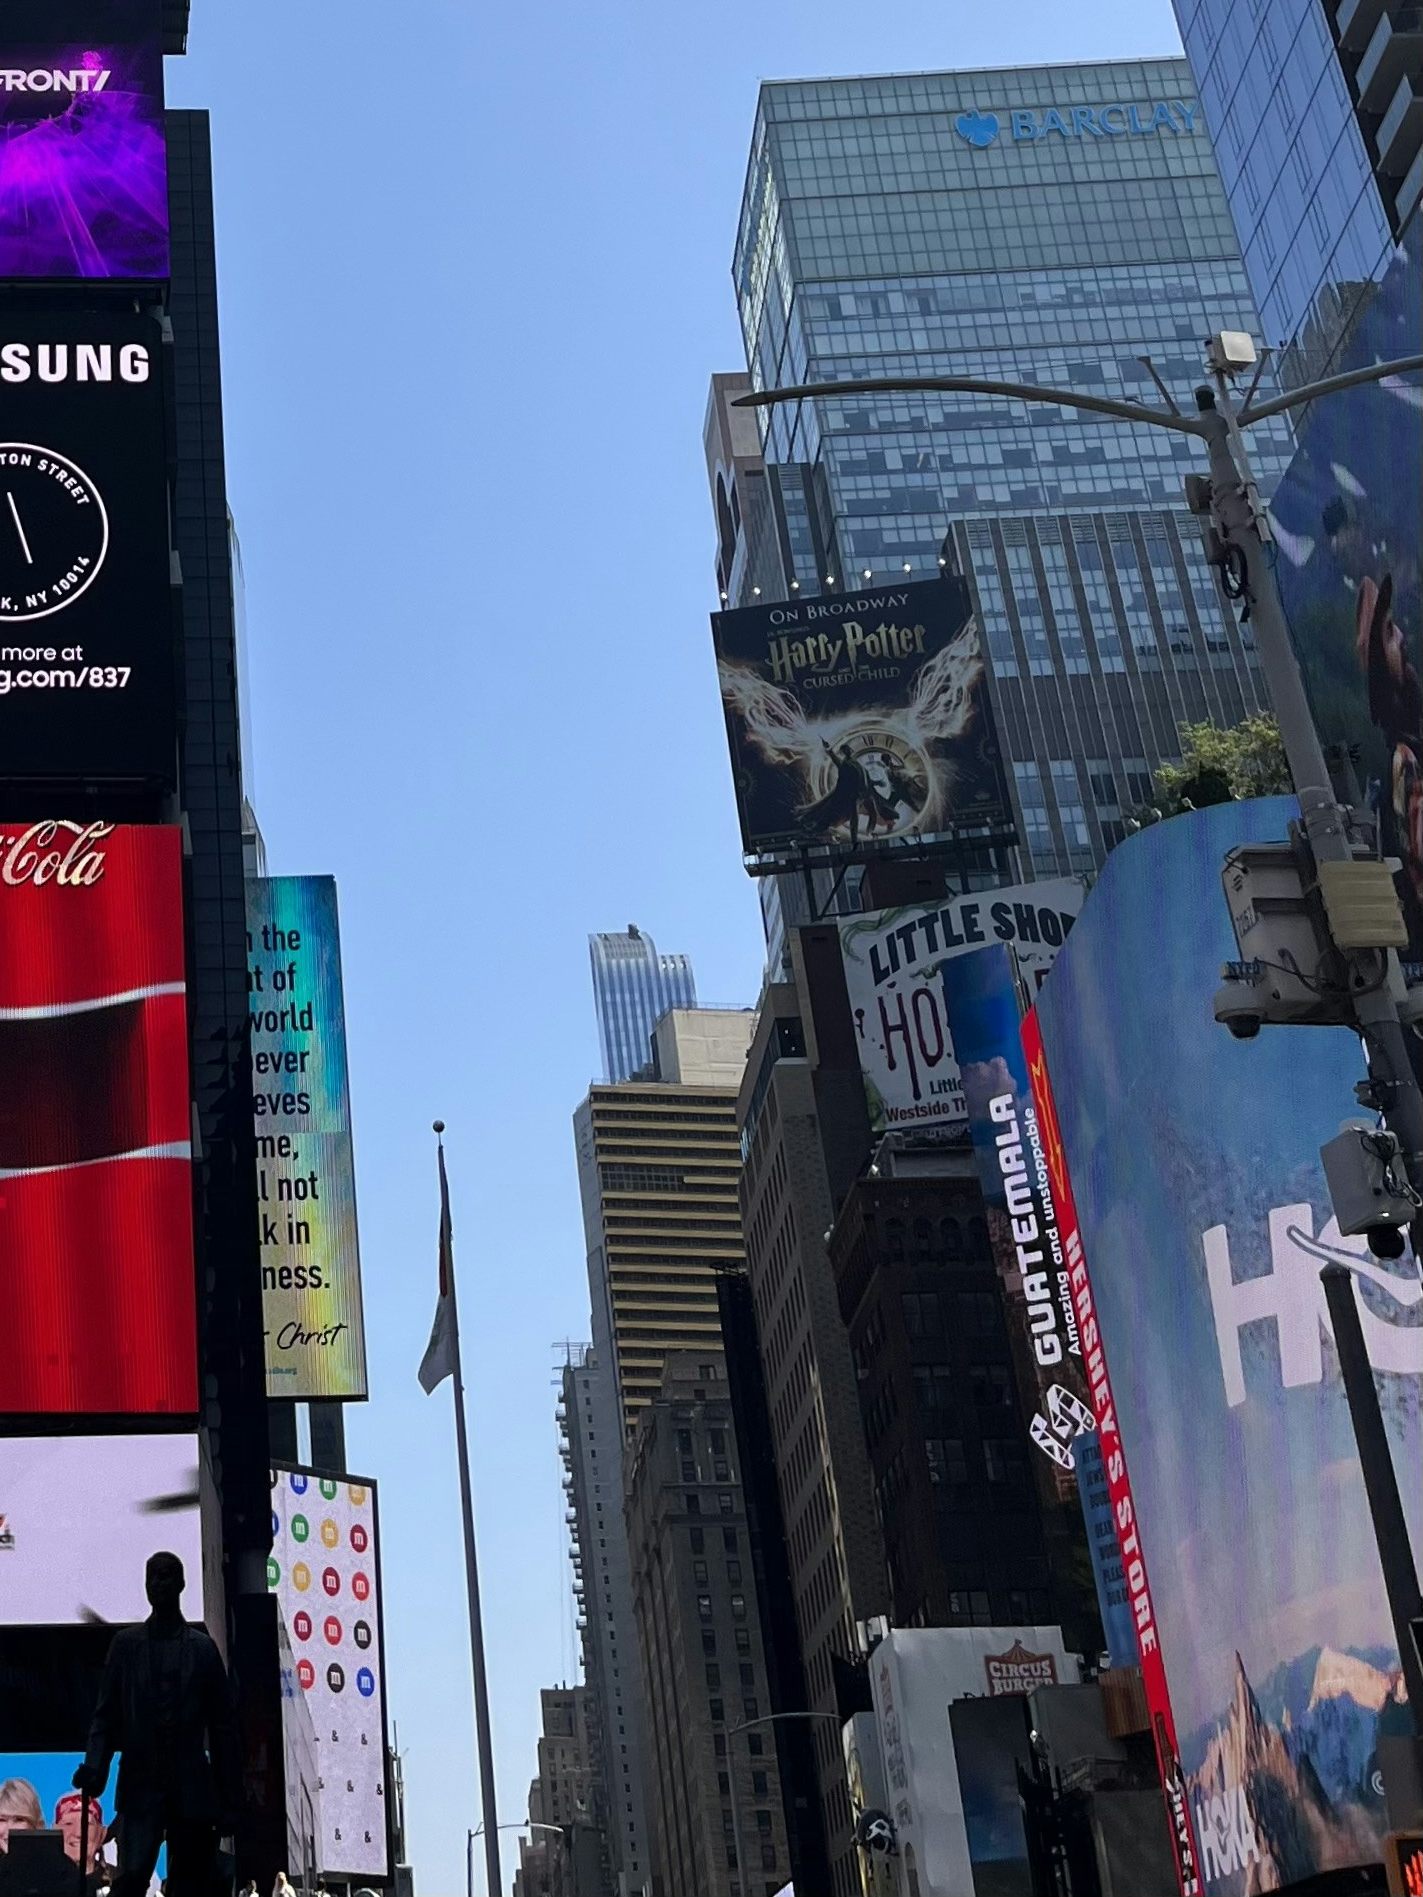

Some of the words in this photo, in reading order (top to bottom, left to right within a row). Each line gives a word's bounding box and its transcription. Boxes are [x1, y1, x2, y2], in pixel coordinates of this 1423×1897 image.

[1010, 100, 1201, 142] BARCLAY
[37, 458, 90, 506] STREET
[26, 590, 48, 609] NY
[52, 555, 91, 597] 10014
[1, 647, 57, 662] more
[61, 645, 84, 662] at
[765, 633, 843, 684] Harry
[842, 621, 926, 677] Potter
[803, 673, 855, 690] CURSED
[858, 666, 901, 681] CHILD
[262, 922, 301, 952] the
[869, 903, 986, 987] LITTLE
[272, 961, 297, 992] of
[253, 1050, 310, 1074] ever
[254, 1091, 311, 1116] eves
[886, 1100, 950, 1122] Westside
[1024, 1107, 1055, 1224] unstoppable
[278, 1170, 320, 1202] not
[287, 1213, 311, 1245] in
[989, 1093, 1063, 1366] GUATEMALA
[1045, 1228, 1064, 1265] and
[262, 1264, 331, 1290] ness.
[1057, 1271, 1082, 1356] Amazing
[276, 1321, 348, 1350] Christ
[1065, 1229, 1125, 1484] HERSHEY'S
[1116, 1494, 1157, 1657] STORE
[295, 1522, 306, 1535] m
[325, 1527, 335, 1540] m
[354, 1532, 364, 1545] m
[297, 1570, 306, 1583] m
[326, 1575, 336, 1588] m
[355, 1580, 366, 1593] m
[298, 1619, 308, 1632] m
[328, 1624, 338, 1637] m
[358, 1629, 368, 1641] m
[300, 1668, 311, 1681] m
[331, 1672, 342, 1685] m
[361, 1676, 371, 1689] m
[989, 1659, 1052, 1678] CIRCUS
[1196, 1785, 1261, 1882] HOKA
